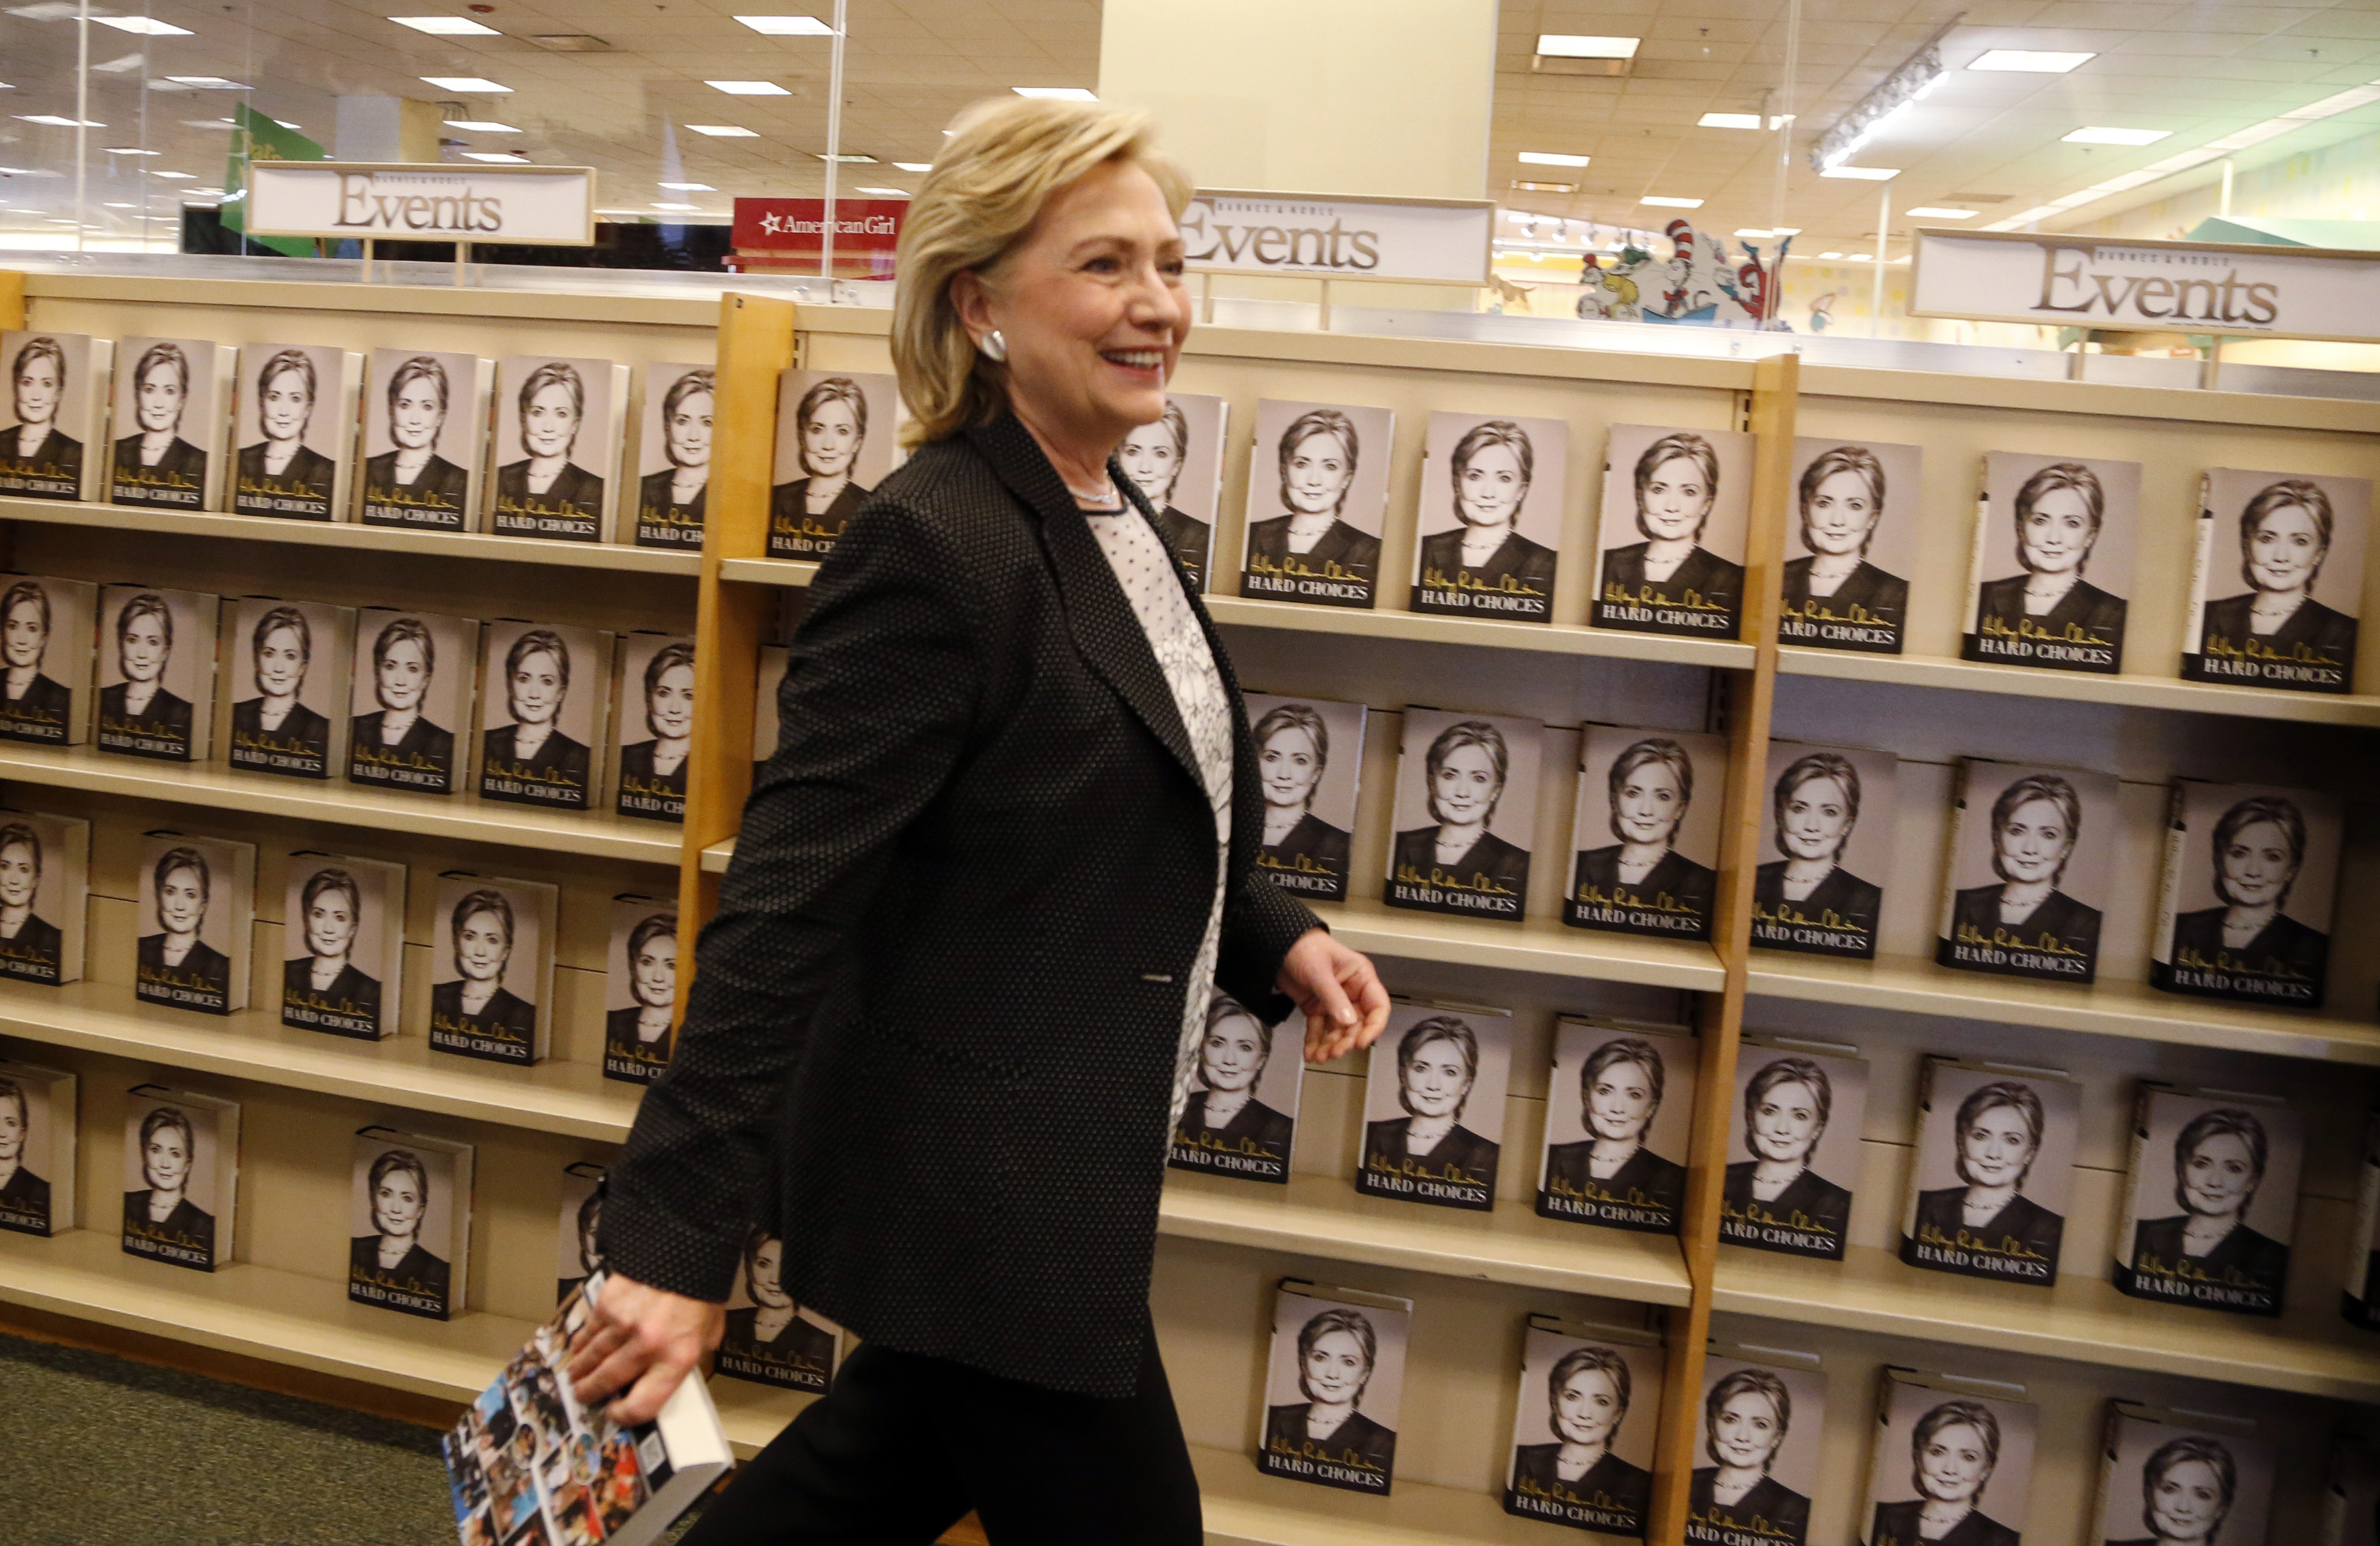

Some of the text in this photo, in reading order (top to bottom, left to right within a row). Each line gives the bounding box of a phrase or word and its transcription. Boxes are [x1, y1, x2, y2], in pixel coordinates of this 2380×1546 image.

[332, 171, 502, 231] Events
[2030, 243, 2278, 324] Events
[0, 477, 75, 494] ARD CHOICES
[114, 486, 199, 503] HARD CHOICES
[238, 495, 326, 514] HARD CHOICES
[366, 505, 458, 524] HARD CHOICES
[497, 516, 595, 534] HARD CHOICES
[640, 526, 679, 540] HARD
[772, 537, 813, 551] HARD
[1248, 576, 1367, 599] HARD CHOICES
[1422, 590, 1544, 613] HARD CHOICES
[1603, 605, 1729, 628] HARD CHOICES
[1781, 622, 1894, 644] ARD CHOICES
[1980, 639, 2113, 664] HARD CHOICES
[2205, 658, 2341, 684] HARD CHOICES
[101, 733, 184, 754] HARD CHOICES
[234, 750, 321, 771] HARD CHOICES
[354, 764, 444, 786] HARD CHOICES
[485, 779, 580, 801] HARD CHOICES
[622, 795, 661, 810] HARD
[1269, 871, 1337, 892] CHOICES
[1395, 886, 1516, 912] HARD CHOICES
[1577, 905, 1700, 931] HARD CHOICES
[1754, 925, 1867, 950] ARD CHOICES
[8, 962, 54, 977] CHOICES
[1955, 946, 2086, 973] HARD CHOICES
[139, 983, 222, 1007] HARD CHOICES
[2175, 970, 2311, 998] HARD CHOICES
[285, 1007, 373, 1032] HARD CHOICES
[433, 1030, 526, 1058] HARD CHOICES
[607, 1059, 645, 1075] HARD
[1214, 1156, 1280, 1175] CHOICES
[1367, 1173, 1486, 1202] HARD CHOICES
[1548, 1197, 1669, 1225] HARD CHOICES
[1724, 1222, 1835, 1251] ARD CHOICES
[124, 1236, 207, 1264] HARD CHOICES
[1917, 1245, 2047, 1277] HARD CHOICES
[351, 1283, 441, 1313] HARD CHOICES
[2136, 1275, 2271, 1306] HARD CHOICES
[723, 1357, 824, 1388] HARD CHOICES
[1269, 1455, 1384, 1487] HARD CHOICES
[1516, 1496, 1635, 1527] HARD CHOICES
[1688, 1525, 1719, 1541] ARD
